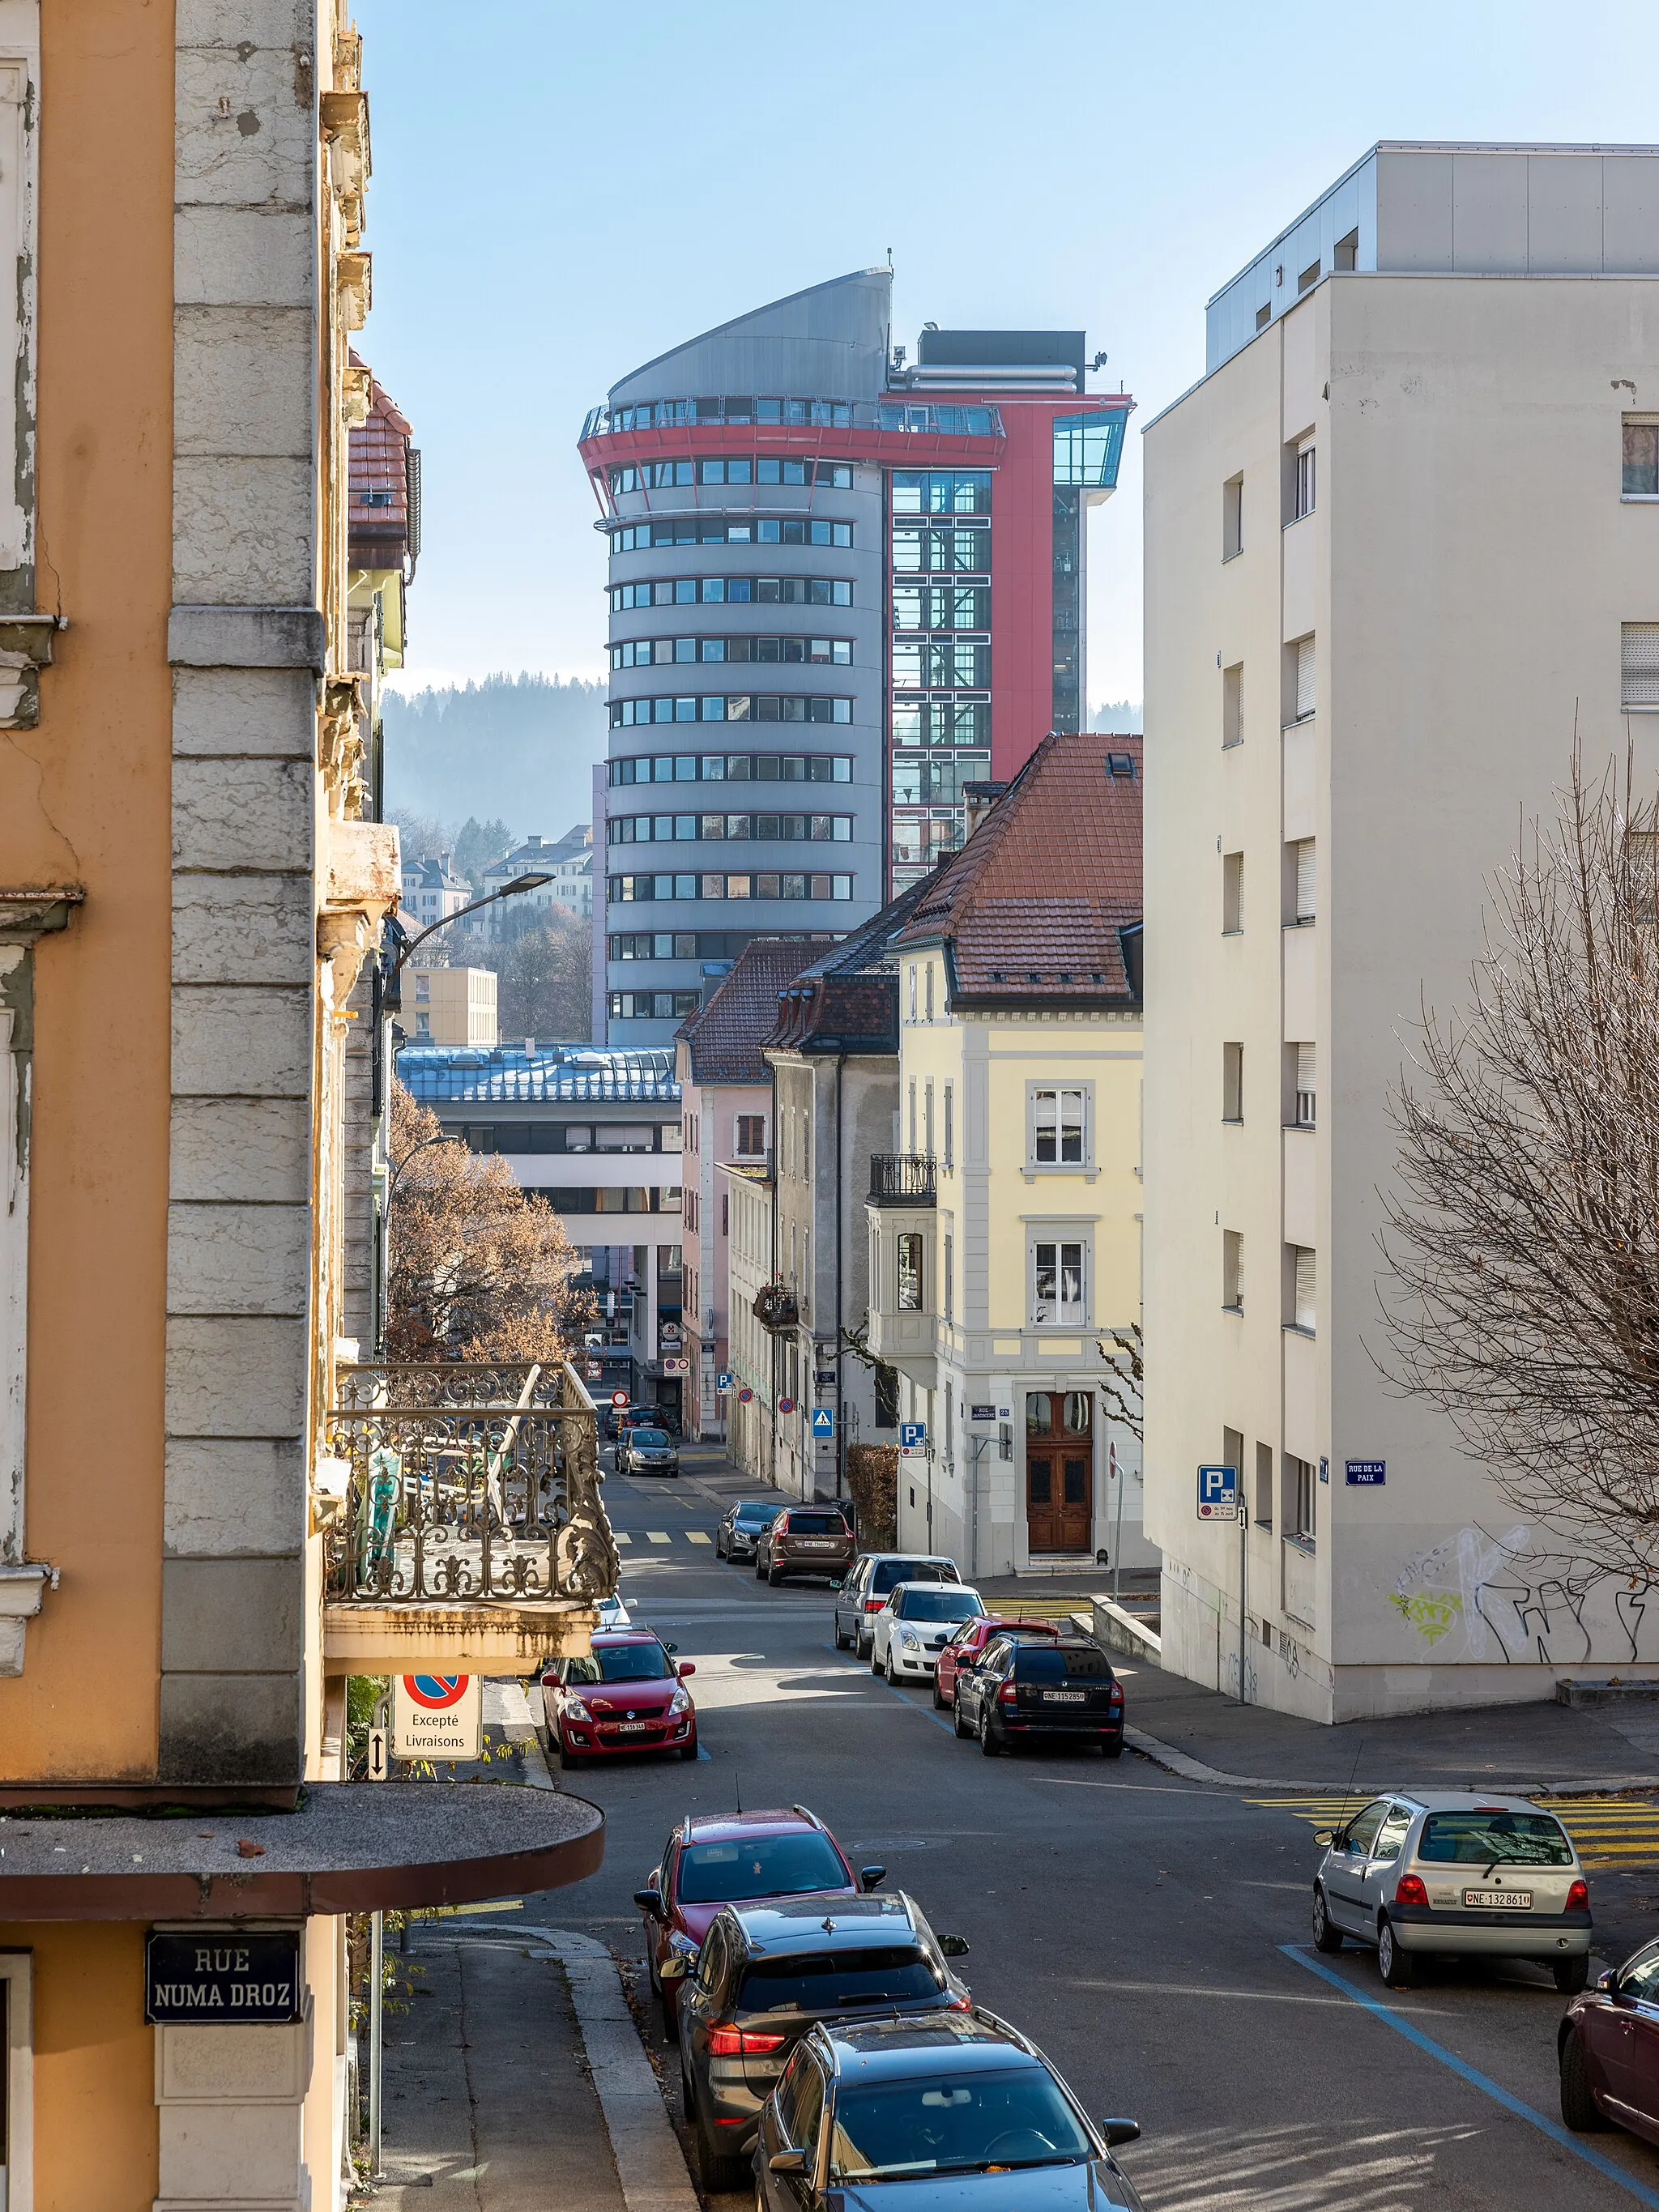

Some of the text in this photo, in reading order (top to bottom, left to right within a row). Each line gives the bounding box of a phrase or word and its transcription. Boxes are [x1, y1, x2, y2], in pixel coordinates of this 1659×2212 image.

[905, 1426, 917, 1443] P
[1206, 1471, 1223, 1497] P
[412, 1714, 458, 1729] Excepté
[406, 1734, 464, 1747] Livraisons
[194, 1949, 249, 1971] RUE
[154, 1983, 290, 2007] NUMA DROZ
